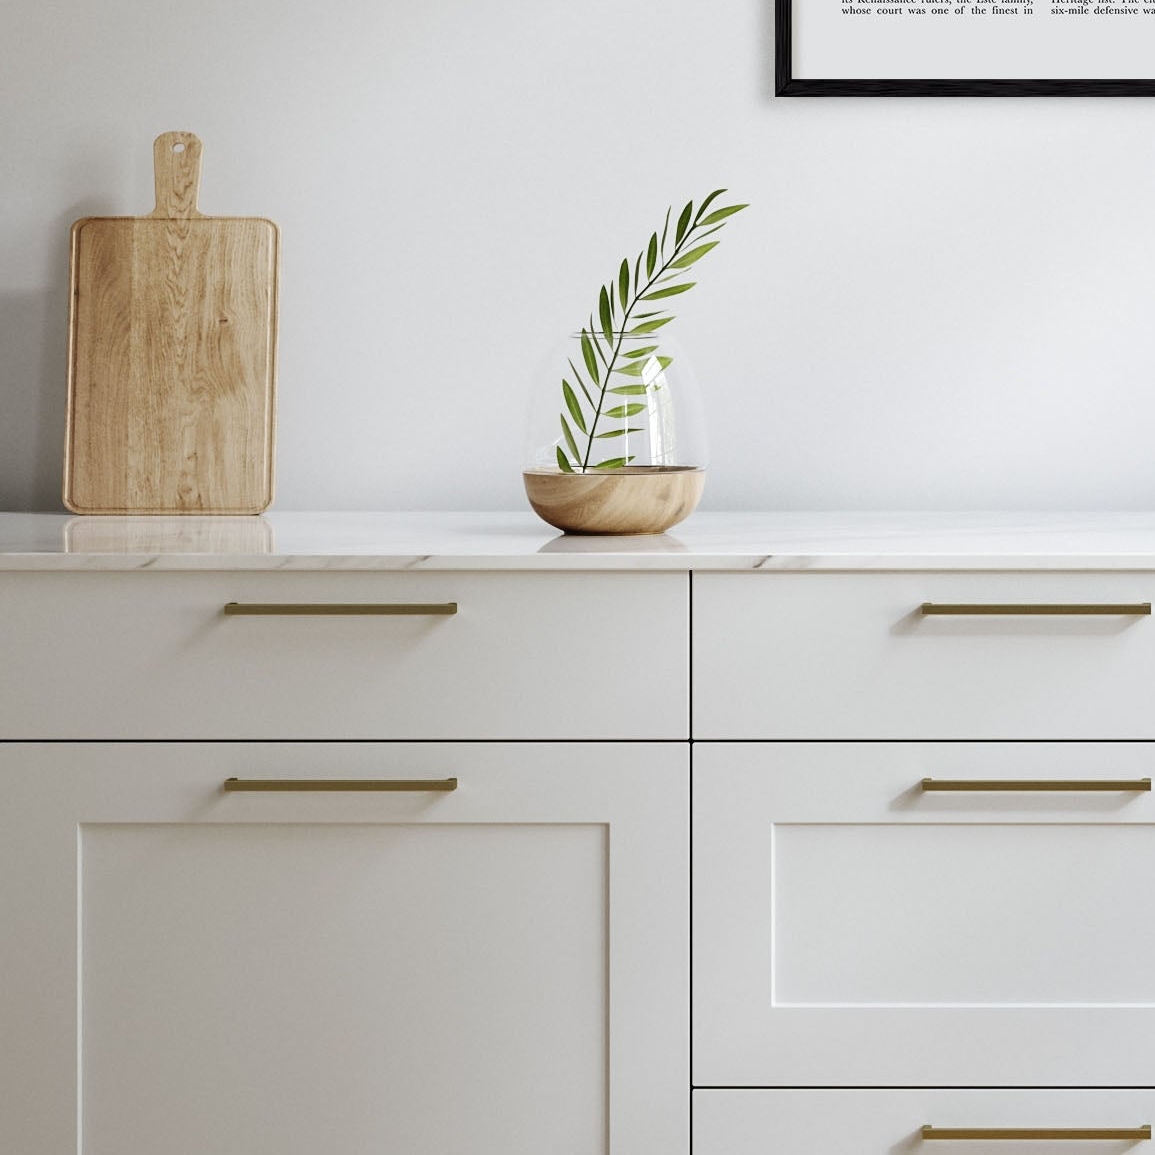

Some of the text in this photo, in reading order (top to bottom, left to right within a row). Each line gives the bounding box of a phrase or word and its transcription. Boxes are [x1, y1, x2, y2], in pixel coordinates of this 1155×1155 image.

[841, 6, 872, 15] whose
[876, 6, 903, 15] court
[954, 6, 966, 15] of
[971, 6, 987, 15] the
[992, 6, 1019, 15] finest
[1023, 6, 1033, 15] in
